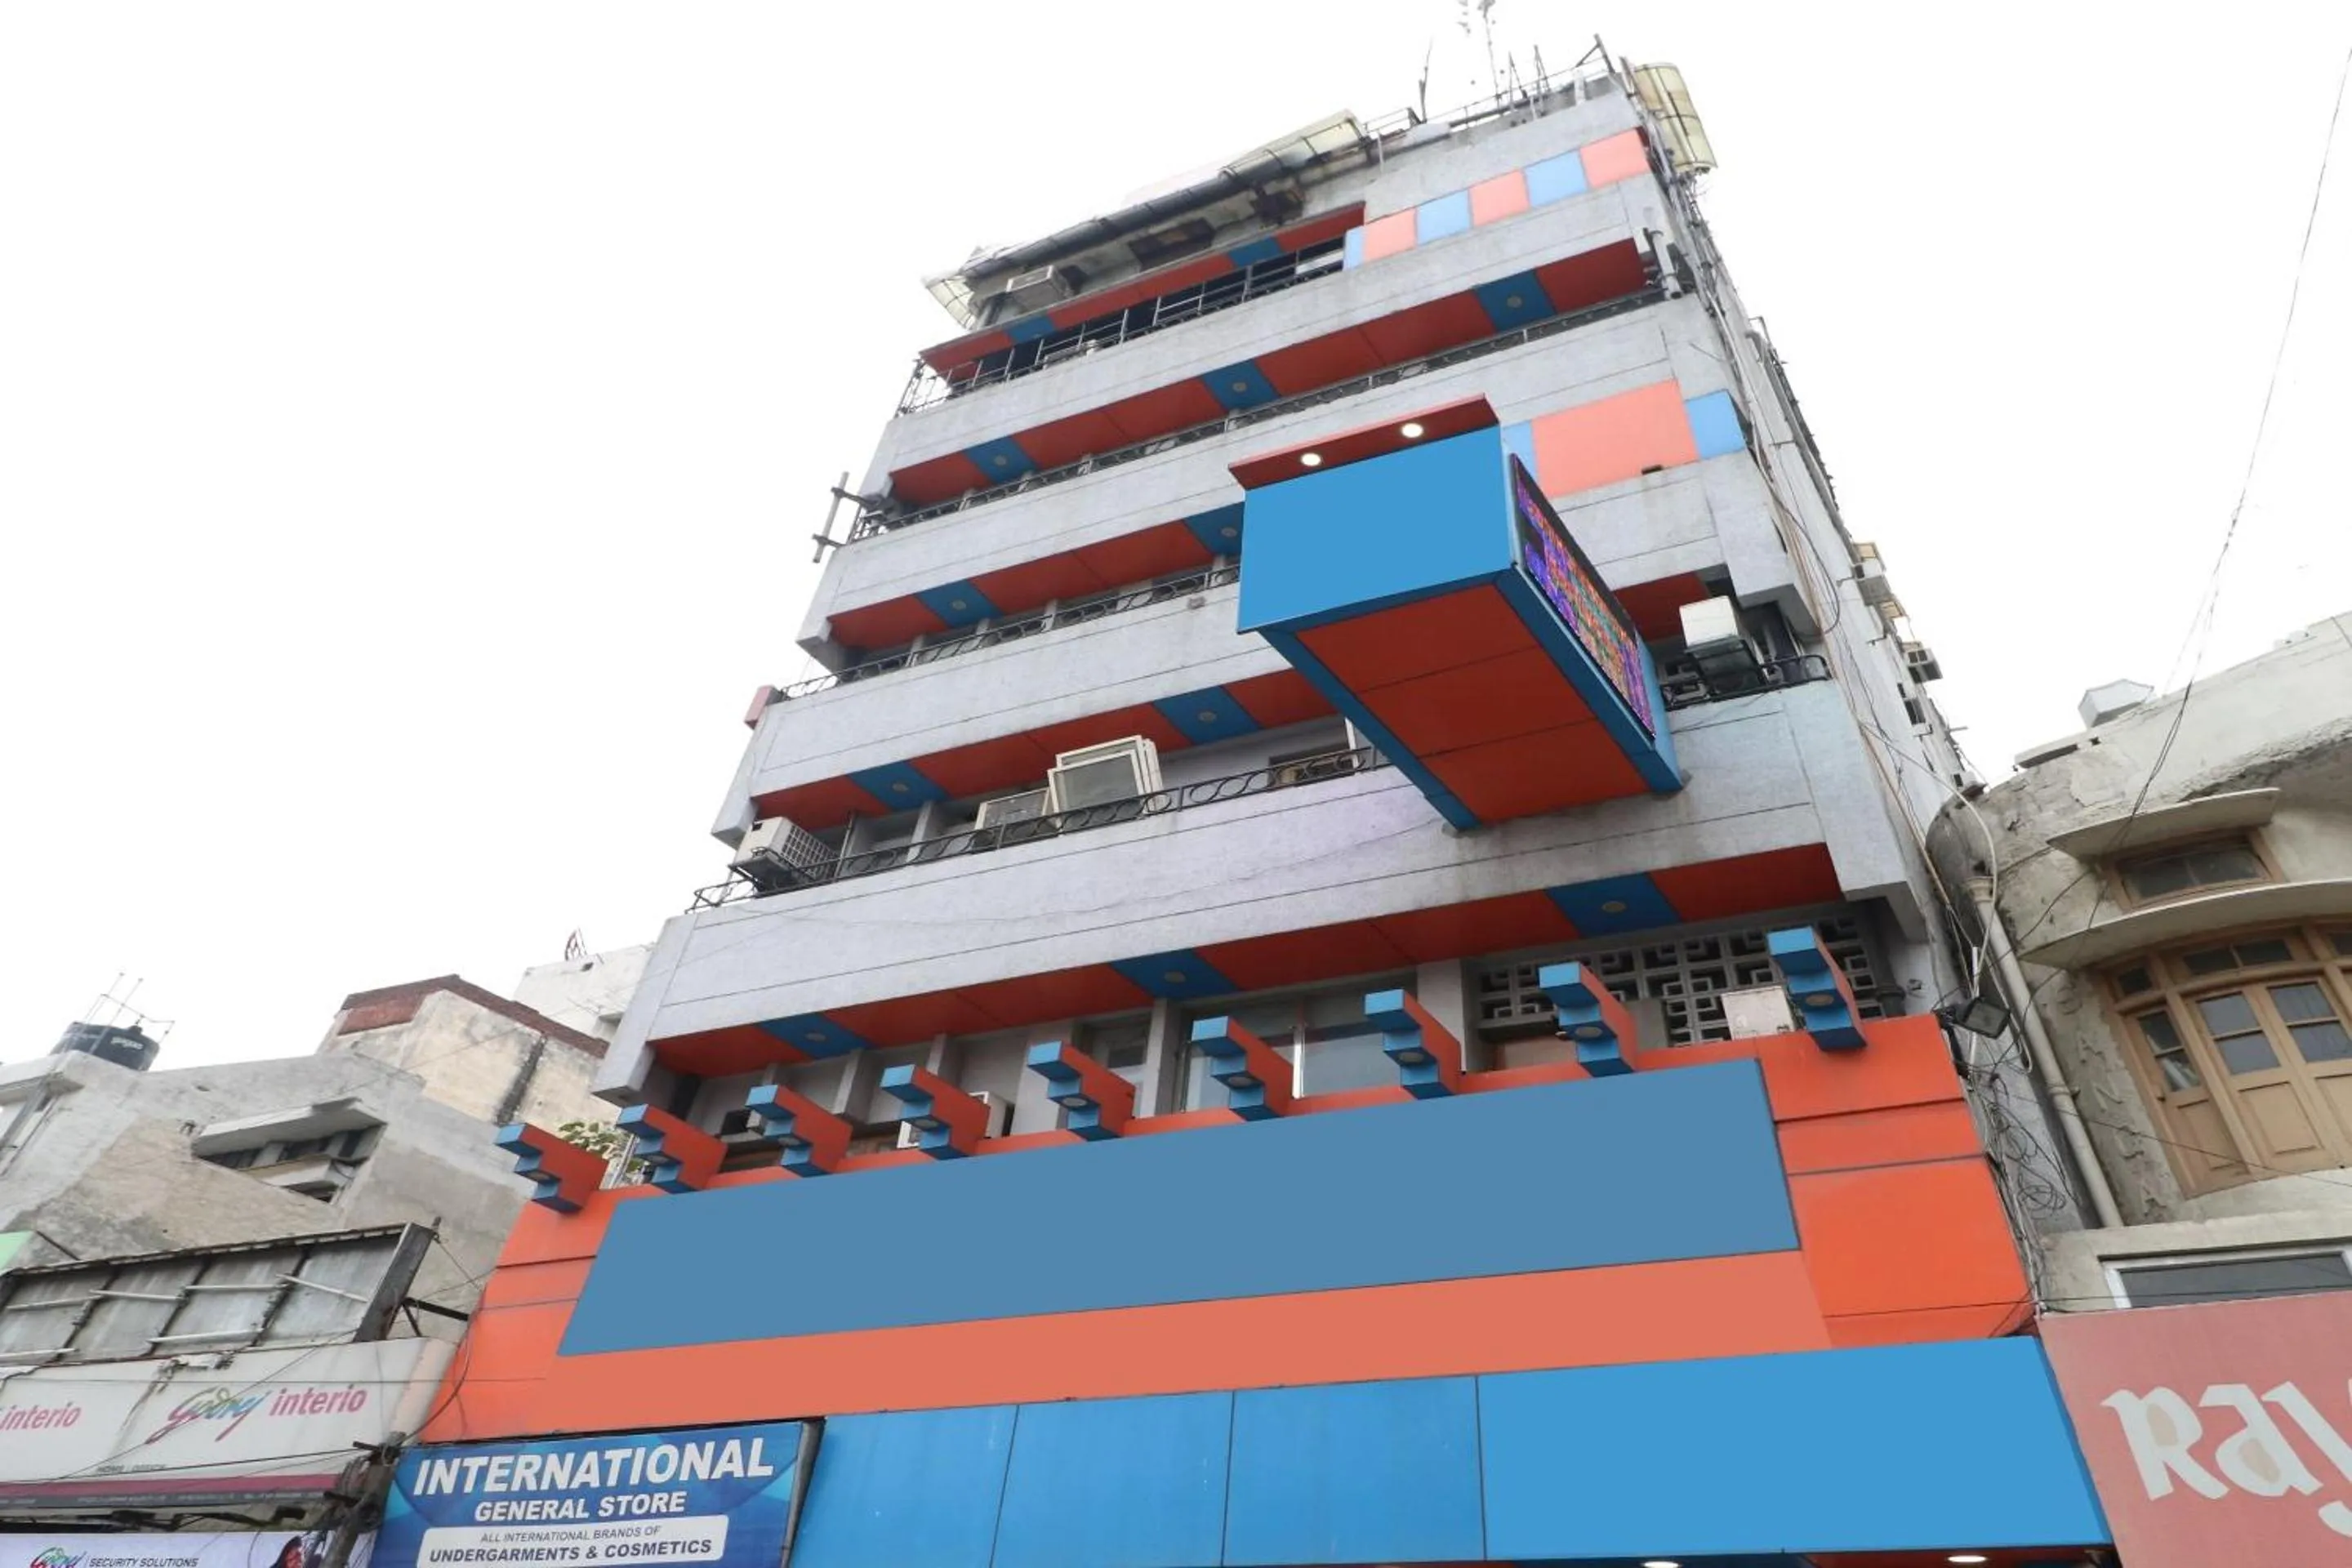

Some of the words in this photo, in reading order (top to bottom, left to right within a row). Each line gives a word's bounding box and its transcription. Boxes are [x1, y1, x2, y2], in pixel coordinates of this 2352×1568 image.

[0, 1401, 82, 1430] interio
[269, 1385, 367, 1417] interio
[412, 1437, 774, 1496] INTERNATIONAL
[474, 1493, 590, 1522] GENERAL
[598, 1490, 687, 1517] STORE
[480, 1532, 502, 1542] ALL
[506, 1528, 589, 1541] INTERNATIONAL
[592, 1526, 641, 1539] BRANDS
[646, 1524, 662, 1537] OF
[89, 1557, 137, 1568] SECURITY
[140, 1557, 198, 1567] SOLUTIONS
[430, 1545, 580, 1563] UNDERGARMENTS
[586, 1546, 598, 1559] &
[604, 1538, 712, 1558] COSMETICS
